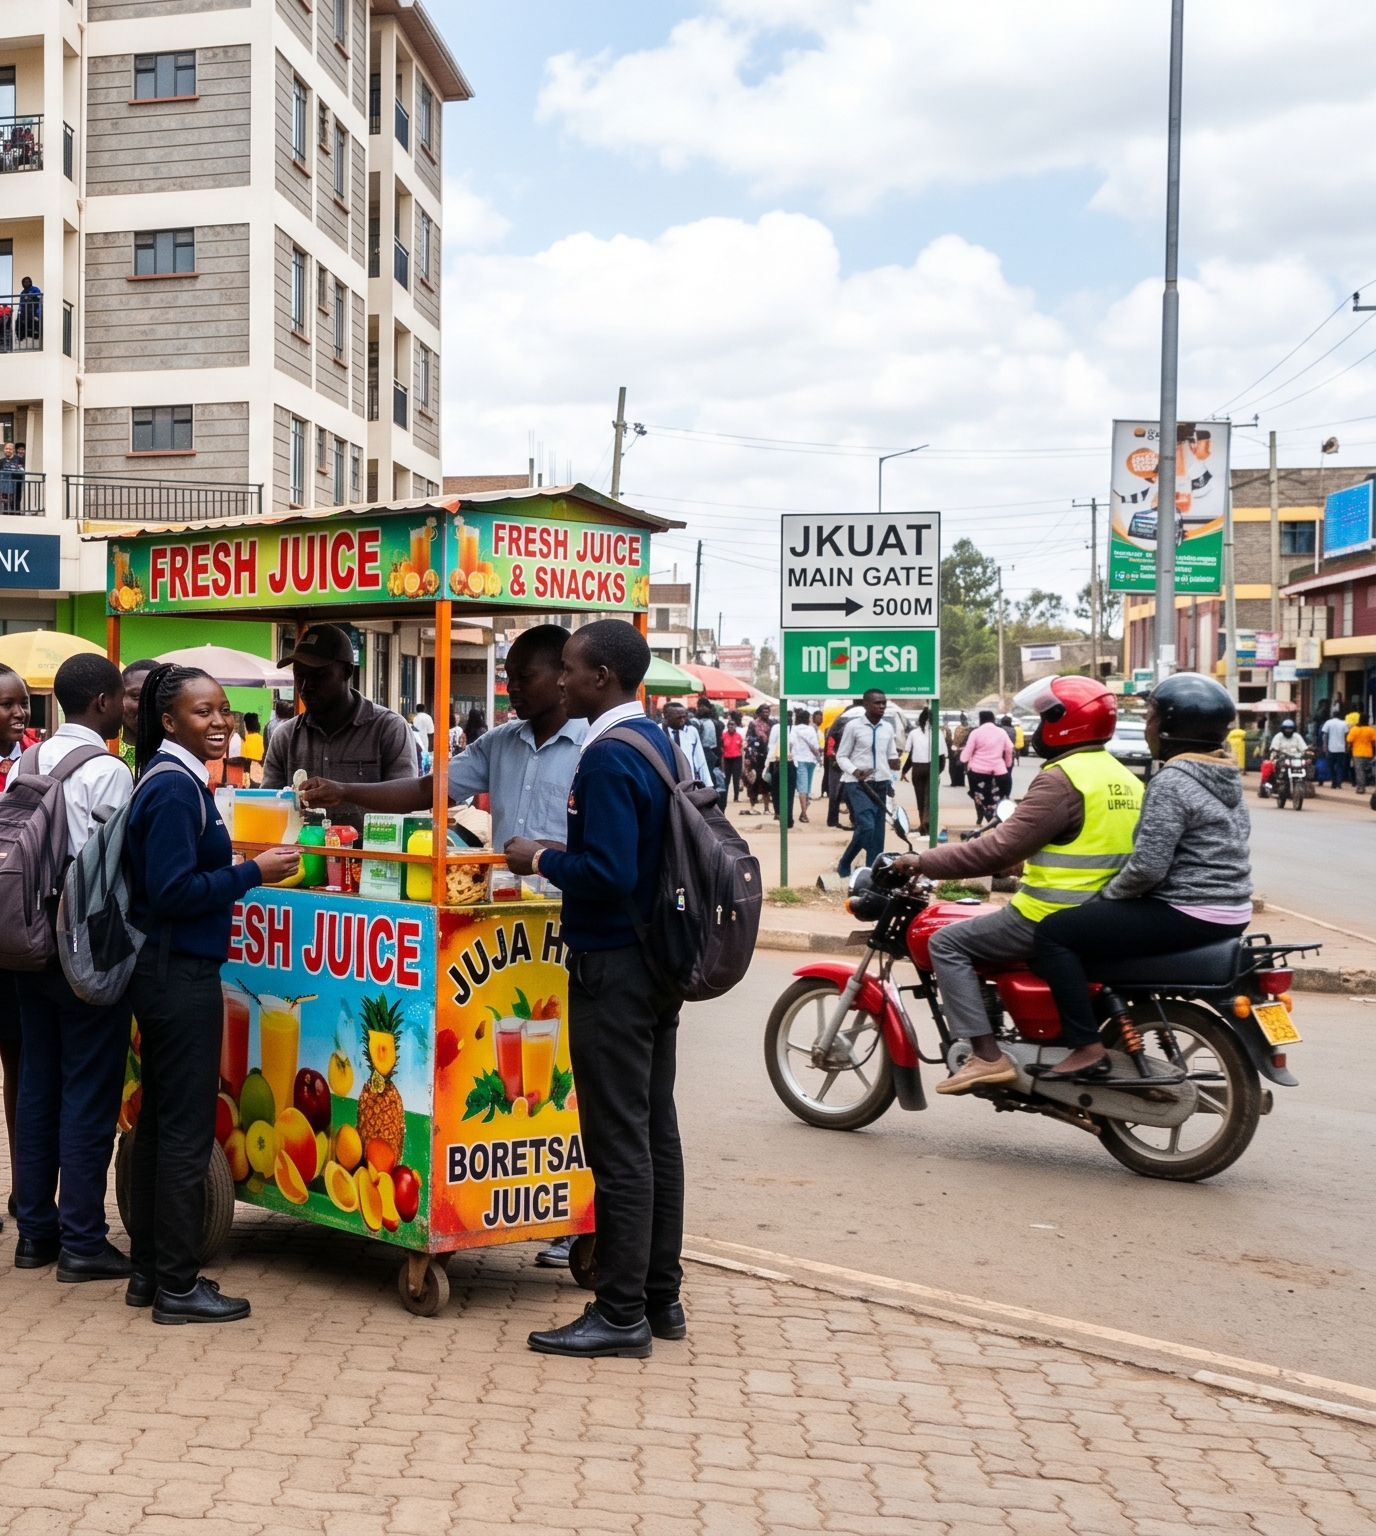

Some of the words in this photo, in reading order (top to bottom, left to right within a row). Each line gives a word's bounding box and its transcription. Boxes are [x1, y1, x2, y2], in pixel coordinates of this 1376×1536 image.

[493, 521, 569, 562] FRESH
[575, 531, 641, 567] JUICE
[789, 524, 932, 557] JKUAT
[150, 538, 258, 602] FRESH
[267, 527, 381, 595] JUICE
[509, 563, 526, 597] &
[534, 565, 626, 605] SNACKS
[788, 567, 853, 587] MAIN
[862, 566, 933, 586] GATE
[872, 597, 933, 616] 500M
[302, 910, 422, 990] JUICE
[446, 920, 533, 1007] JUJA
[540, 920, 571, 974] H
[446, 1133, 589, 1185] BORETSA
[482, 1180, 570, 1229] JUICE
